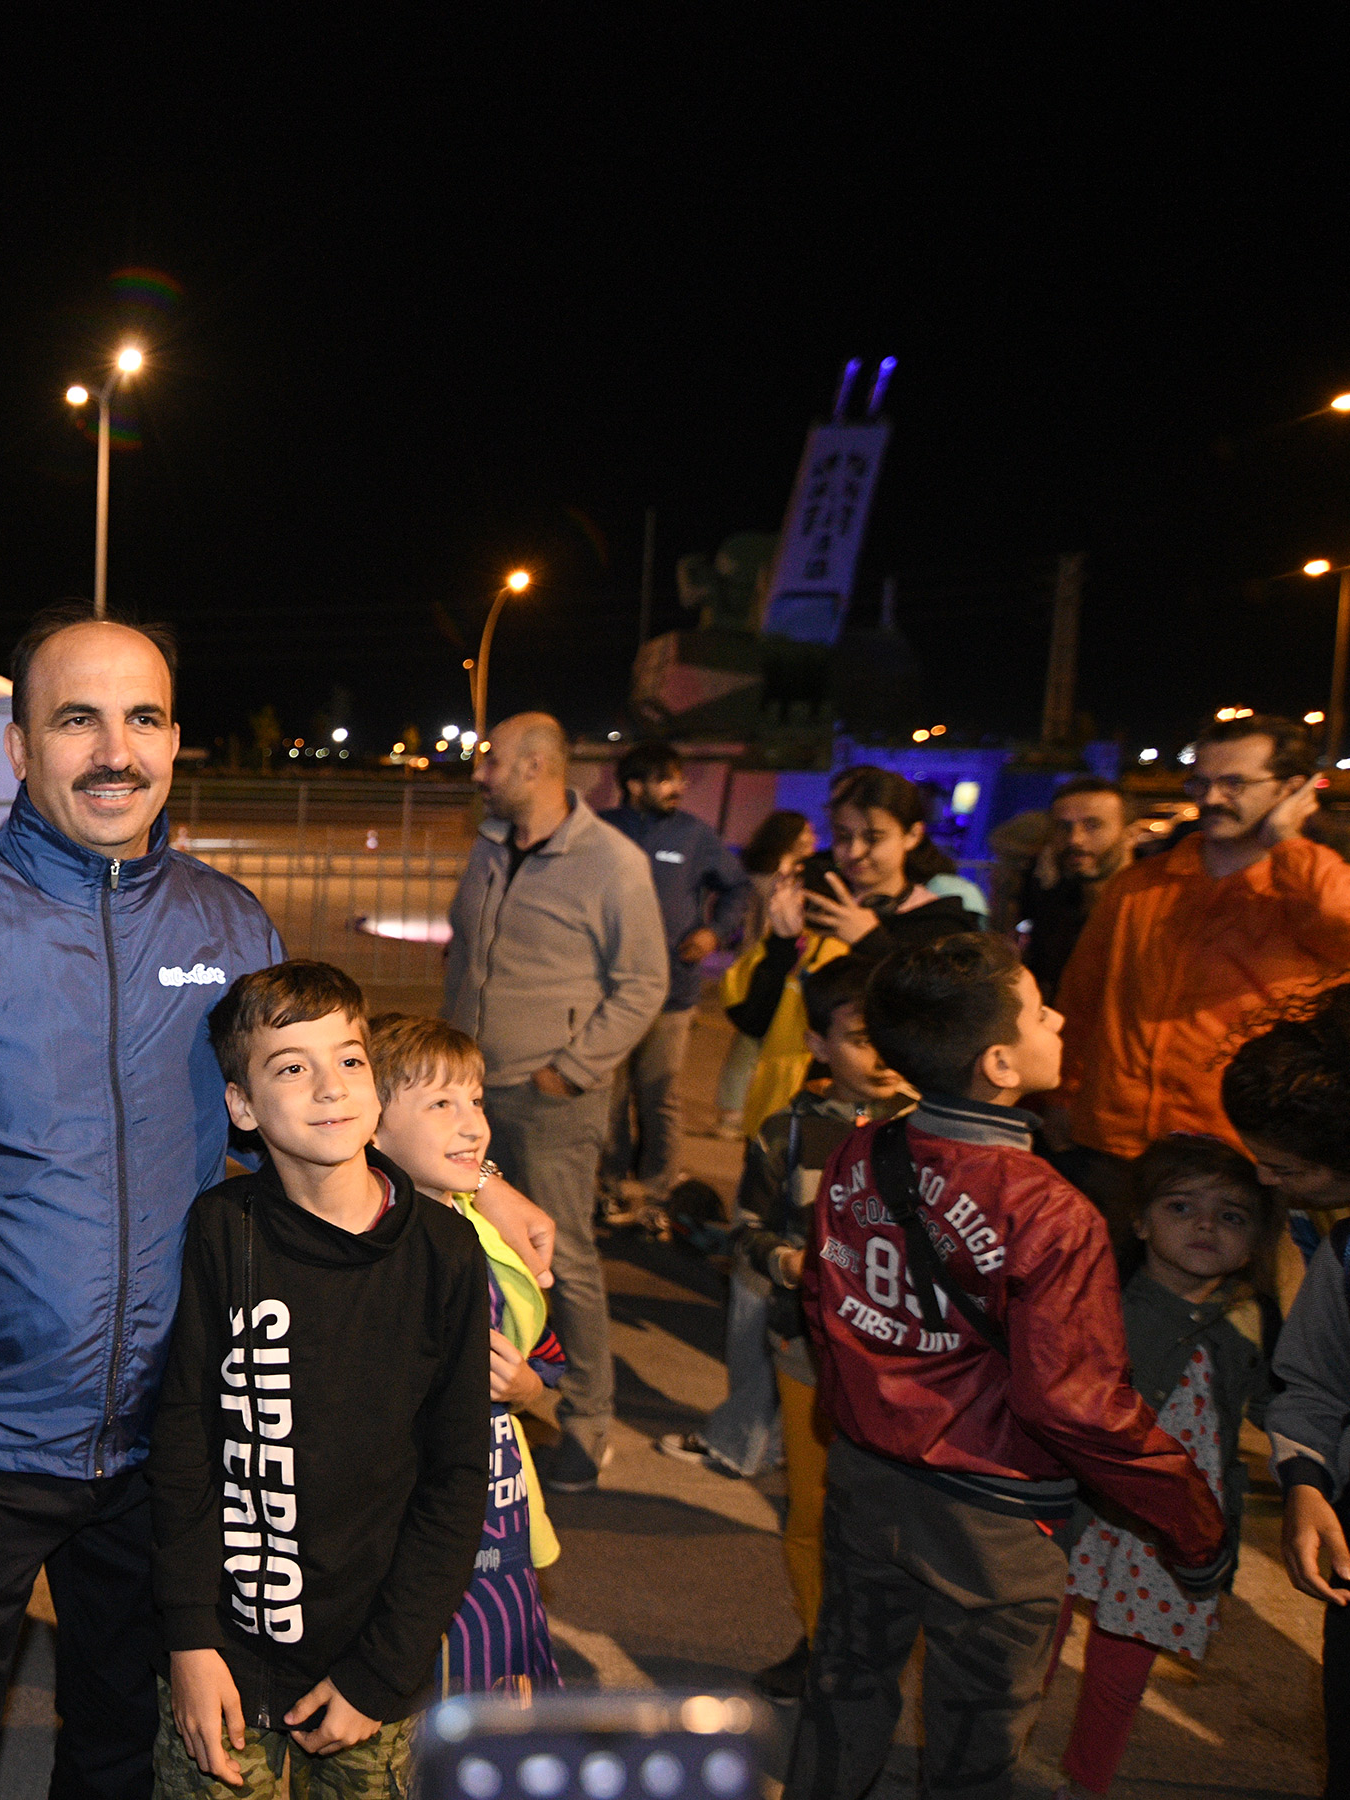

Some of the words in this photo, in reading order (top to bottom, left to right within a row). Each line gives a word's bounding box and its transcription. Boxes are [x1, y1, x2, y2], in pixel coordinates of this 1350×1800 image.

[829, 1159, 867, 1211] SN
[943, 1192, 1007, 1275] HIGH
[837, 1295, 909, 1346] FIRST
[220, 1298, 304, 1644] SUPERIOR
